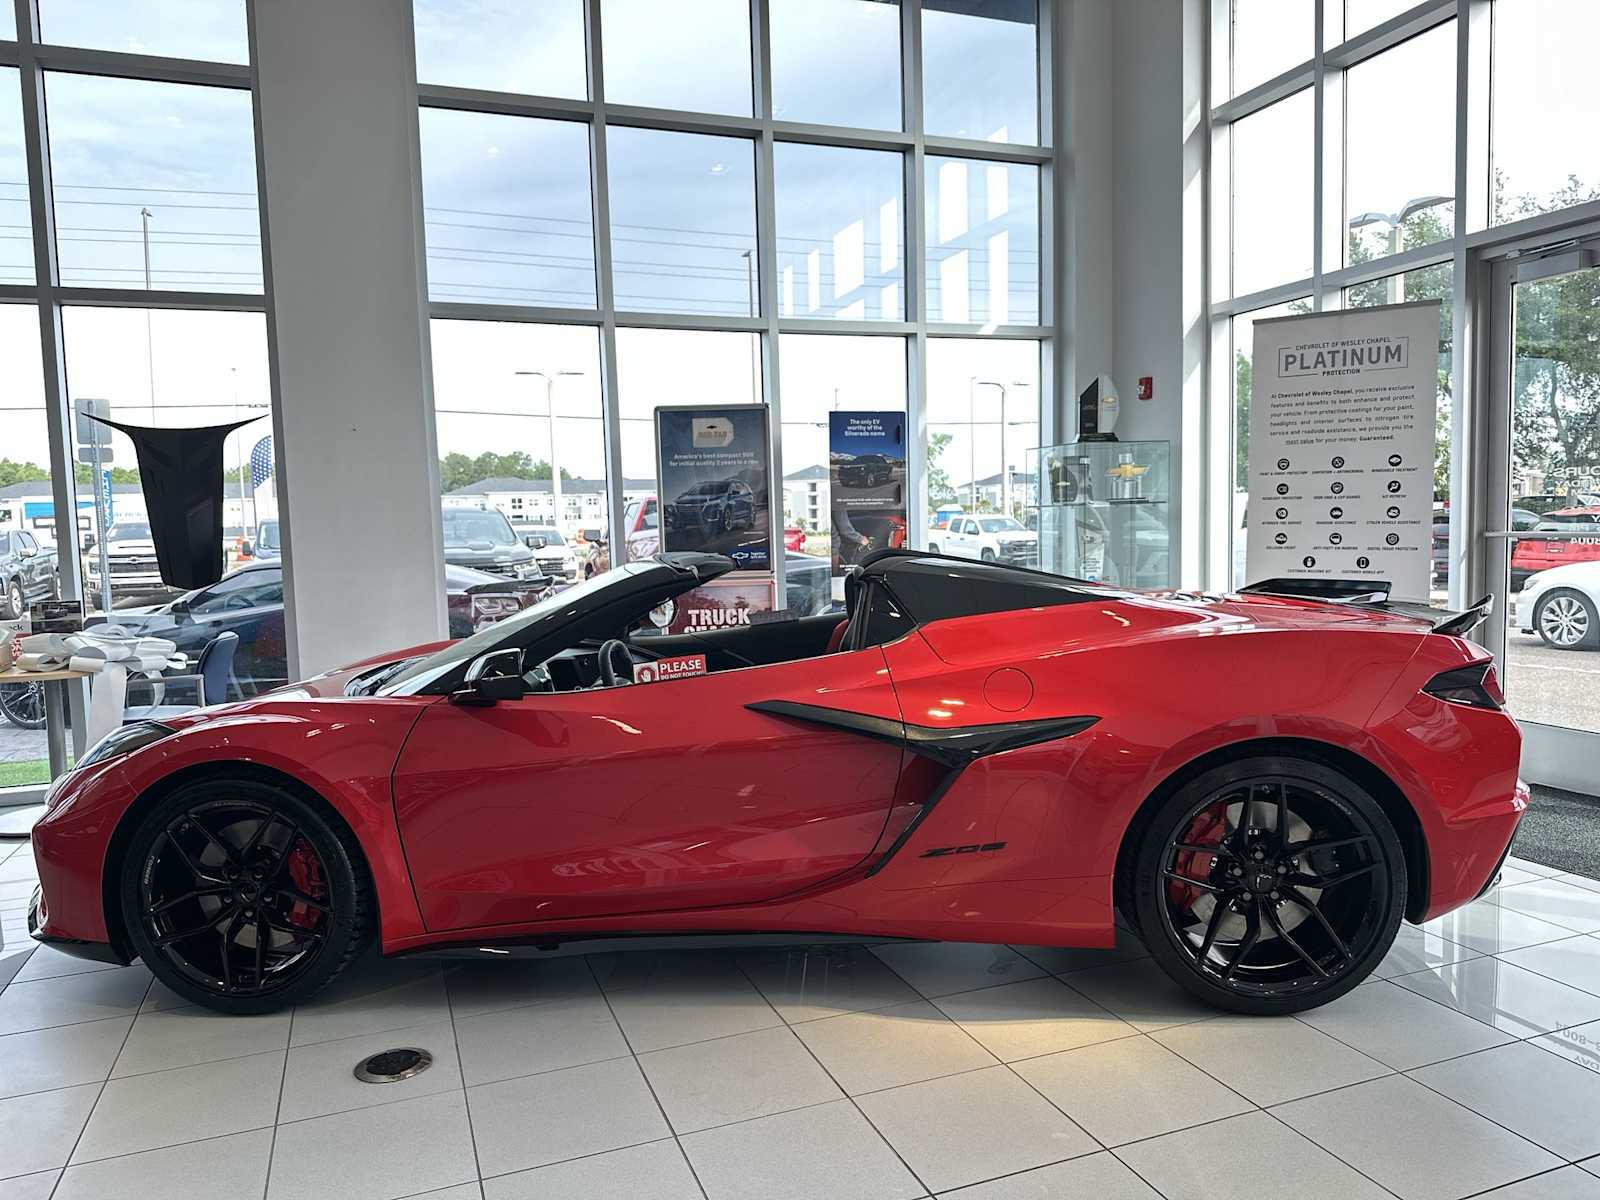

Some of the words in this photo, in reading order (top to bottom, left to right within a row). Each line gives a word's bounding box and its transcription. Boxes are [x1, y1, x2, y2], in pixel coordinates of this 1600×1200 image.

[1296, 342, 1330, 350] CHEVROLET
[1340, 339, 1366, 347] WESLEY
[1366, 336, 1392, 344] CHAPEL
[1284, 343, 1402, 372] PLATINUM
[1322, 367, 1361, 376] PROTECTION
[860, 418, 872, 426] only
[688, 607, 751, 626] TRUCK
[660, 659, 702, 673] PLEASE
